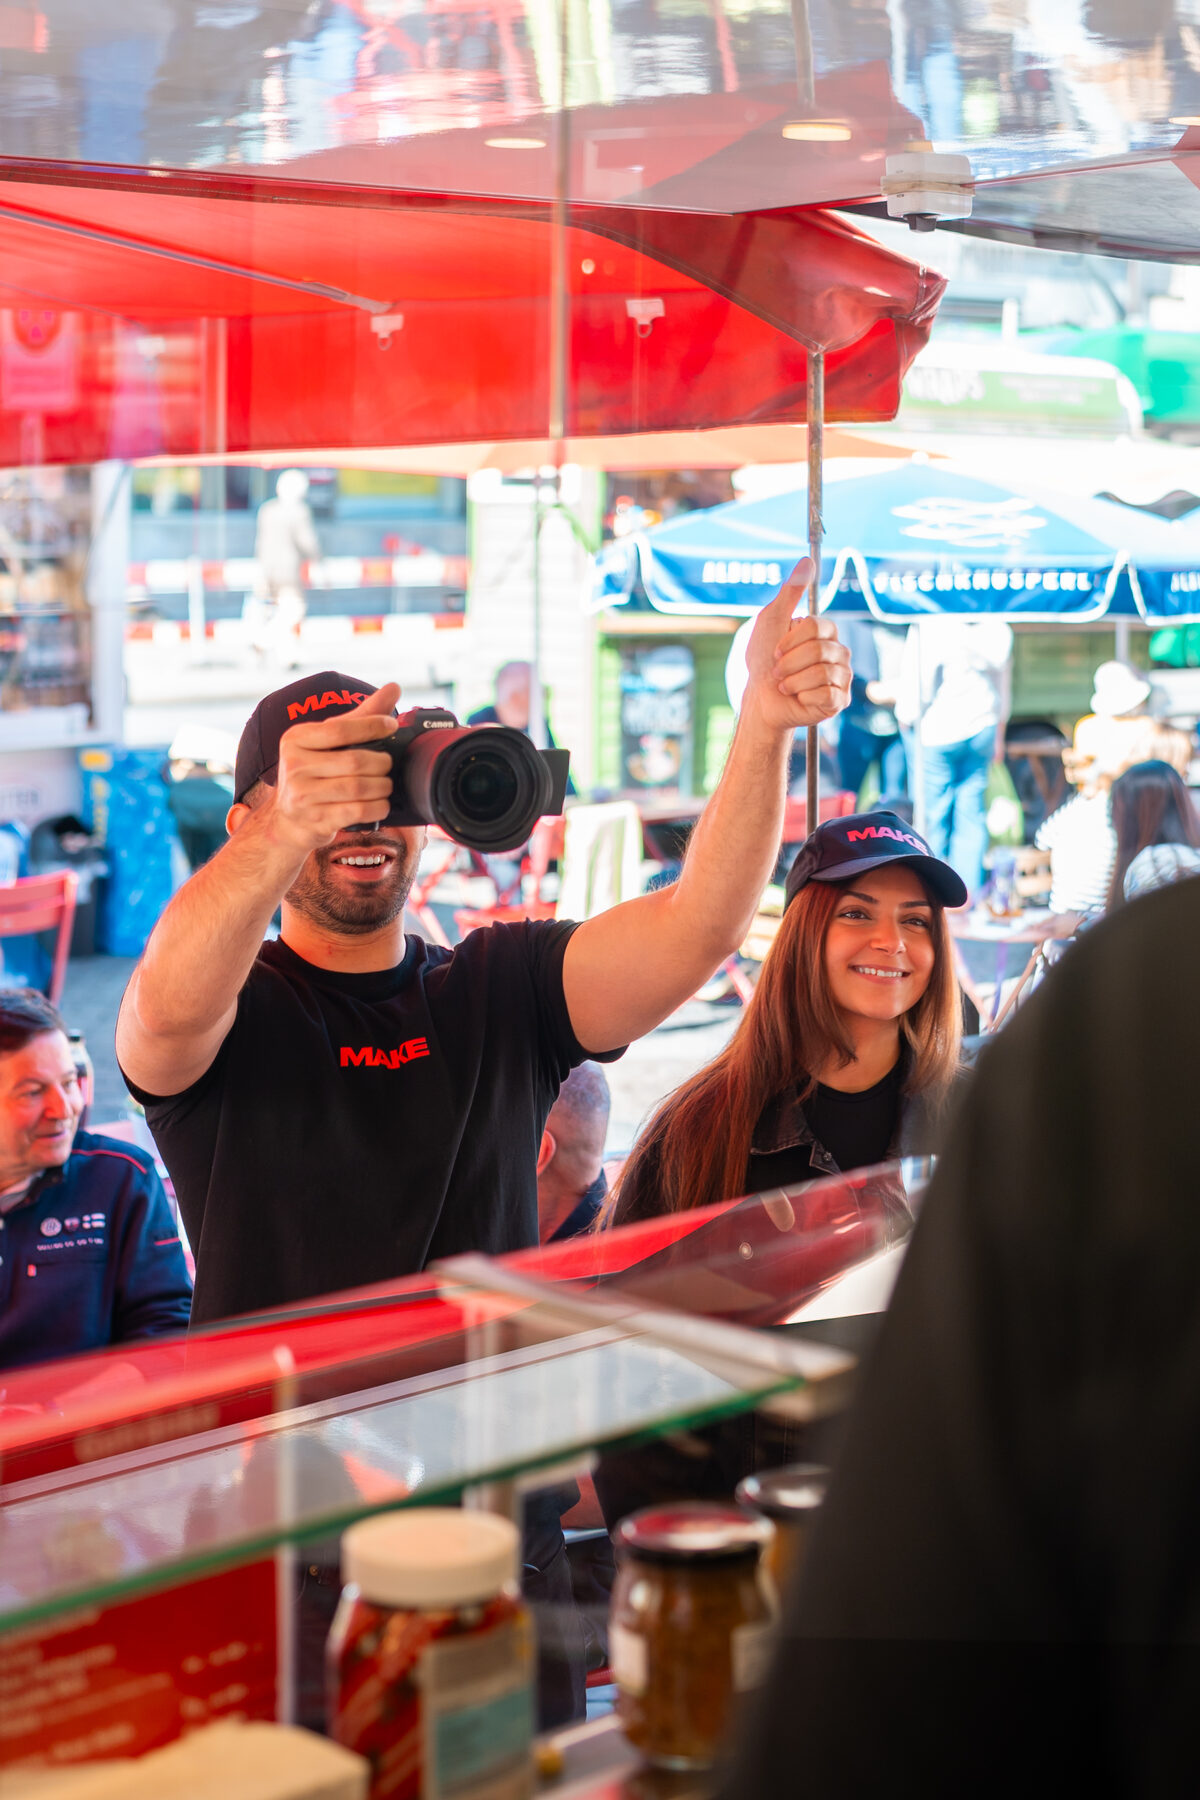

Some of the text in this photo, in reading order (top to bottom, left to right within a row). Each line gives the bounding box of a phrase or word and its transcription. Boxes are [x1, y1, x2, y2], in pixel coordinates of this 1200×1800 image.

[287, 690, 371, 721] MAK
[423, 720, 454, 729] Canon
[340, 1036, 430, 1070] MAKE
